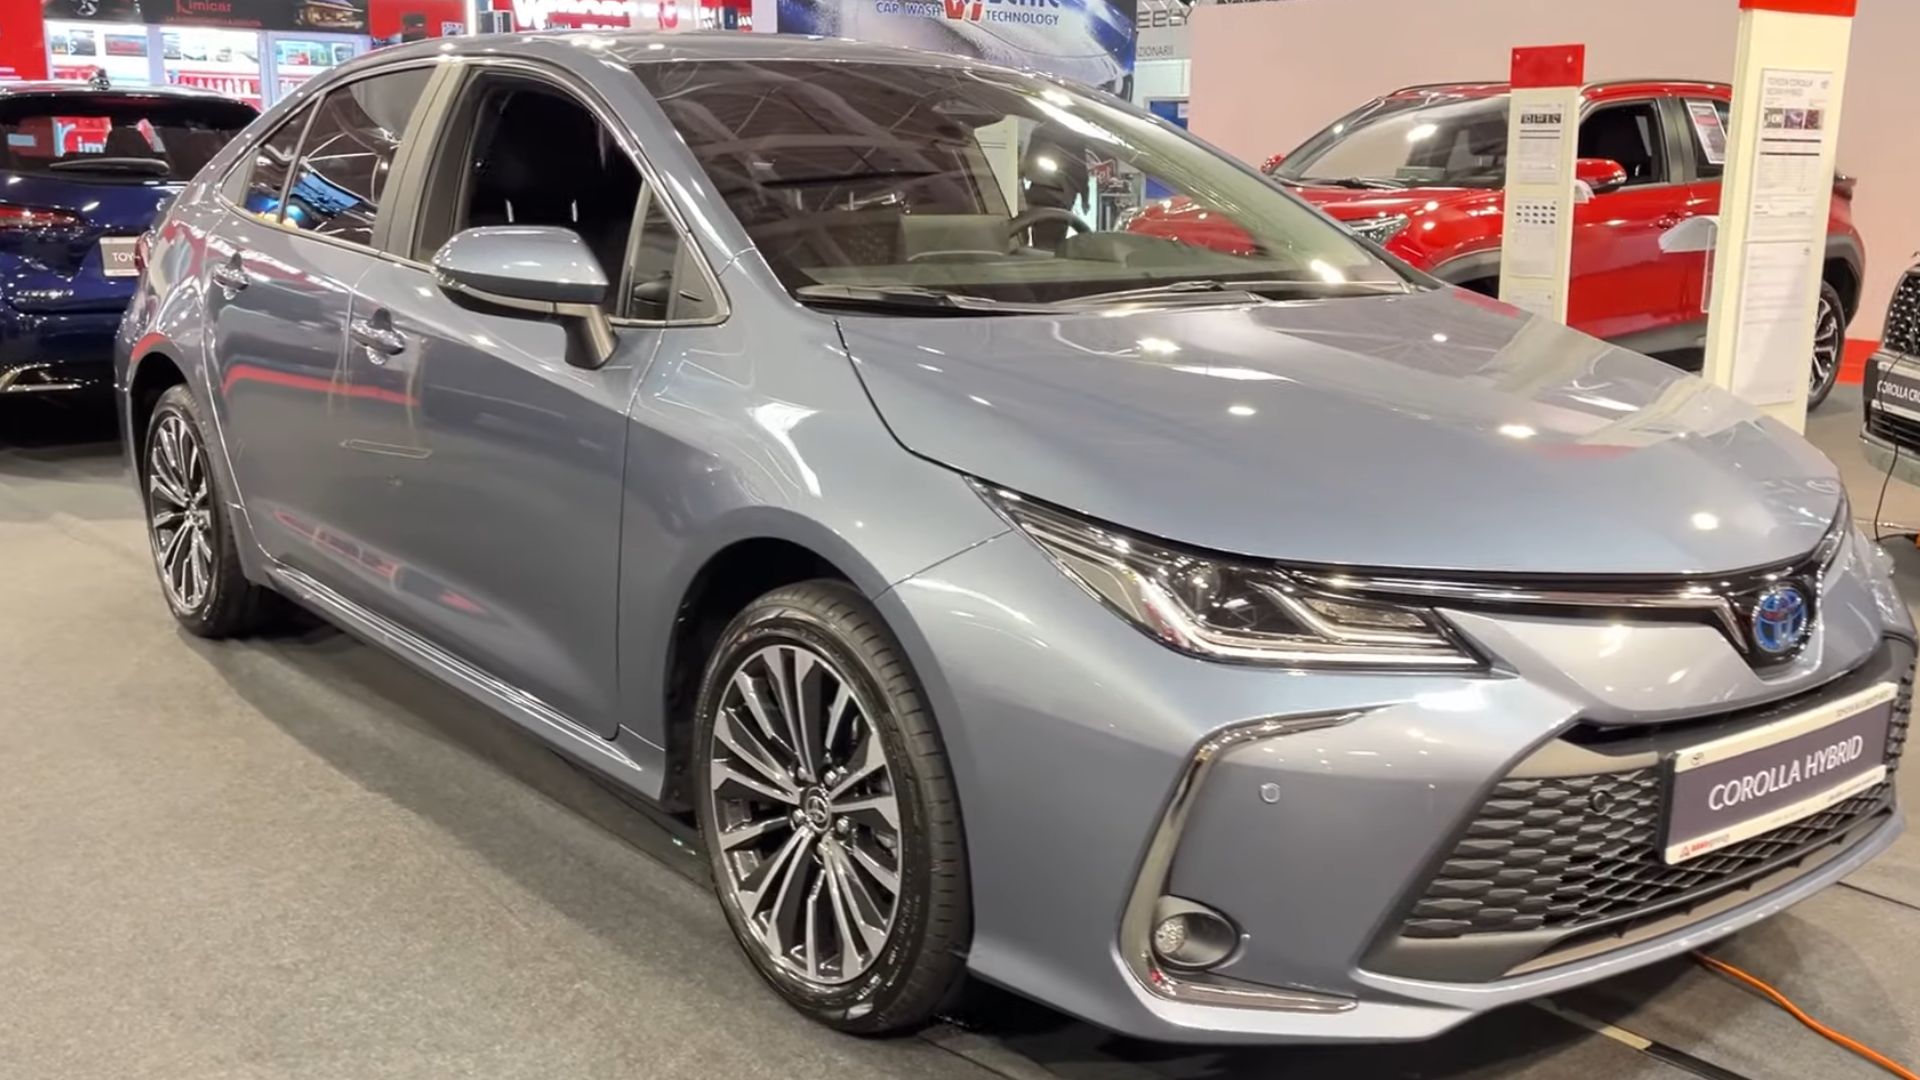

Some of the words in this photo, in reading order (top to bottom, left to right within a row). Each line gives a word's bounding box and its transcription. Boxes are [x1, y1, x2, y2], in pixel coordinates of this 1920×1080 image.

[875, 2, 898, 14] CAR
[906, 4, 942, 17] WASH
[986, 10, 1060, 26] TECHNOLOGY
[1137, 7, 1193, 28] EELY
[1877, 380, 1908, 399] COROLLA
[1708, 759, 1802, 811] COROLLA
[1804, 735, 1864, 779] HYBRID
